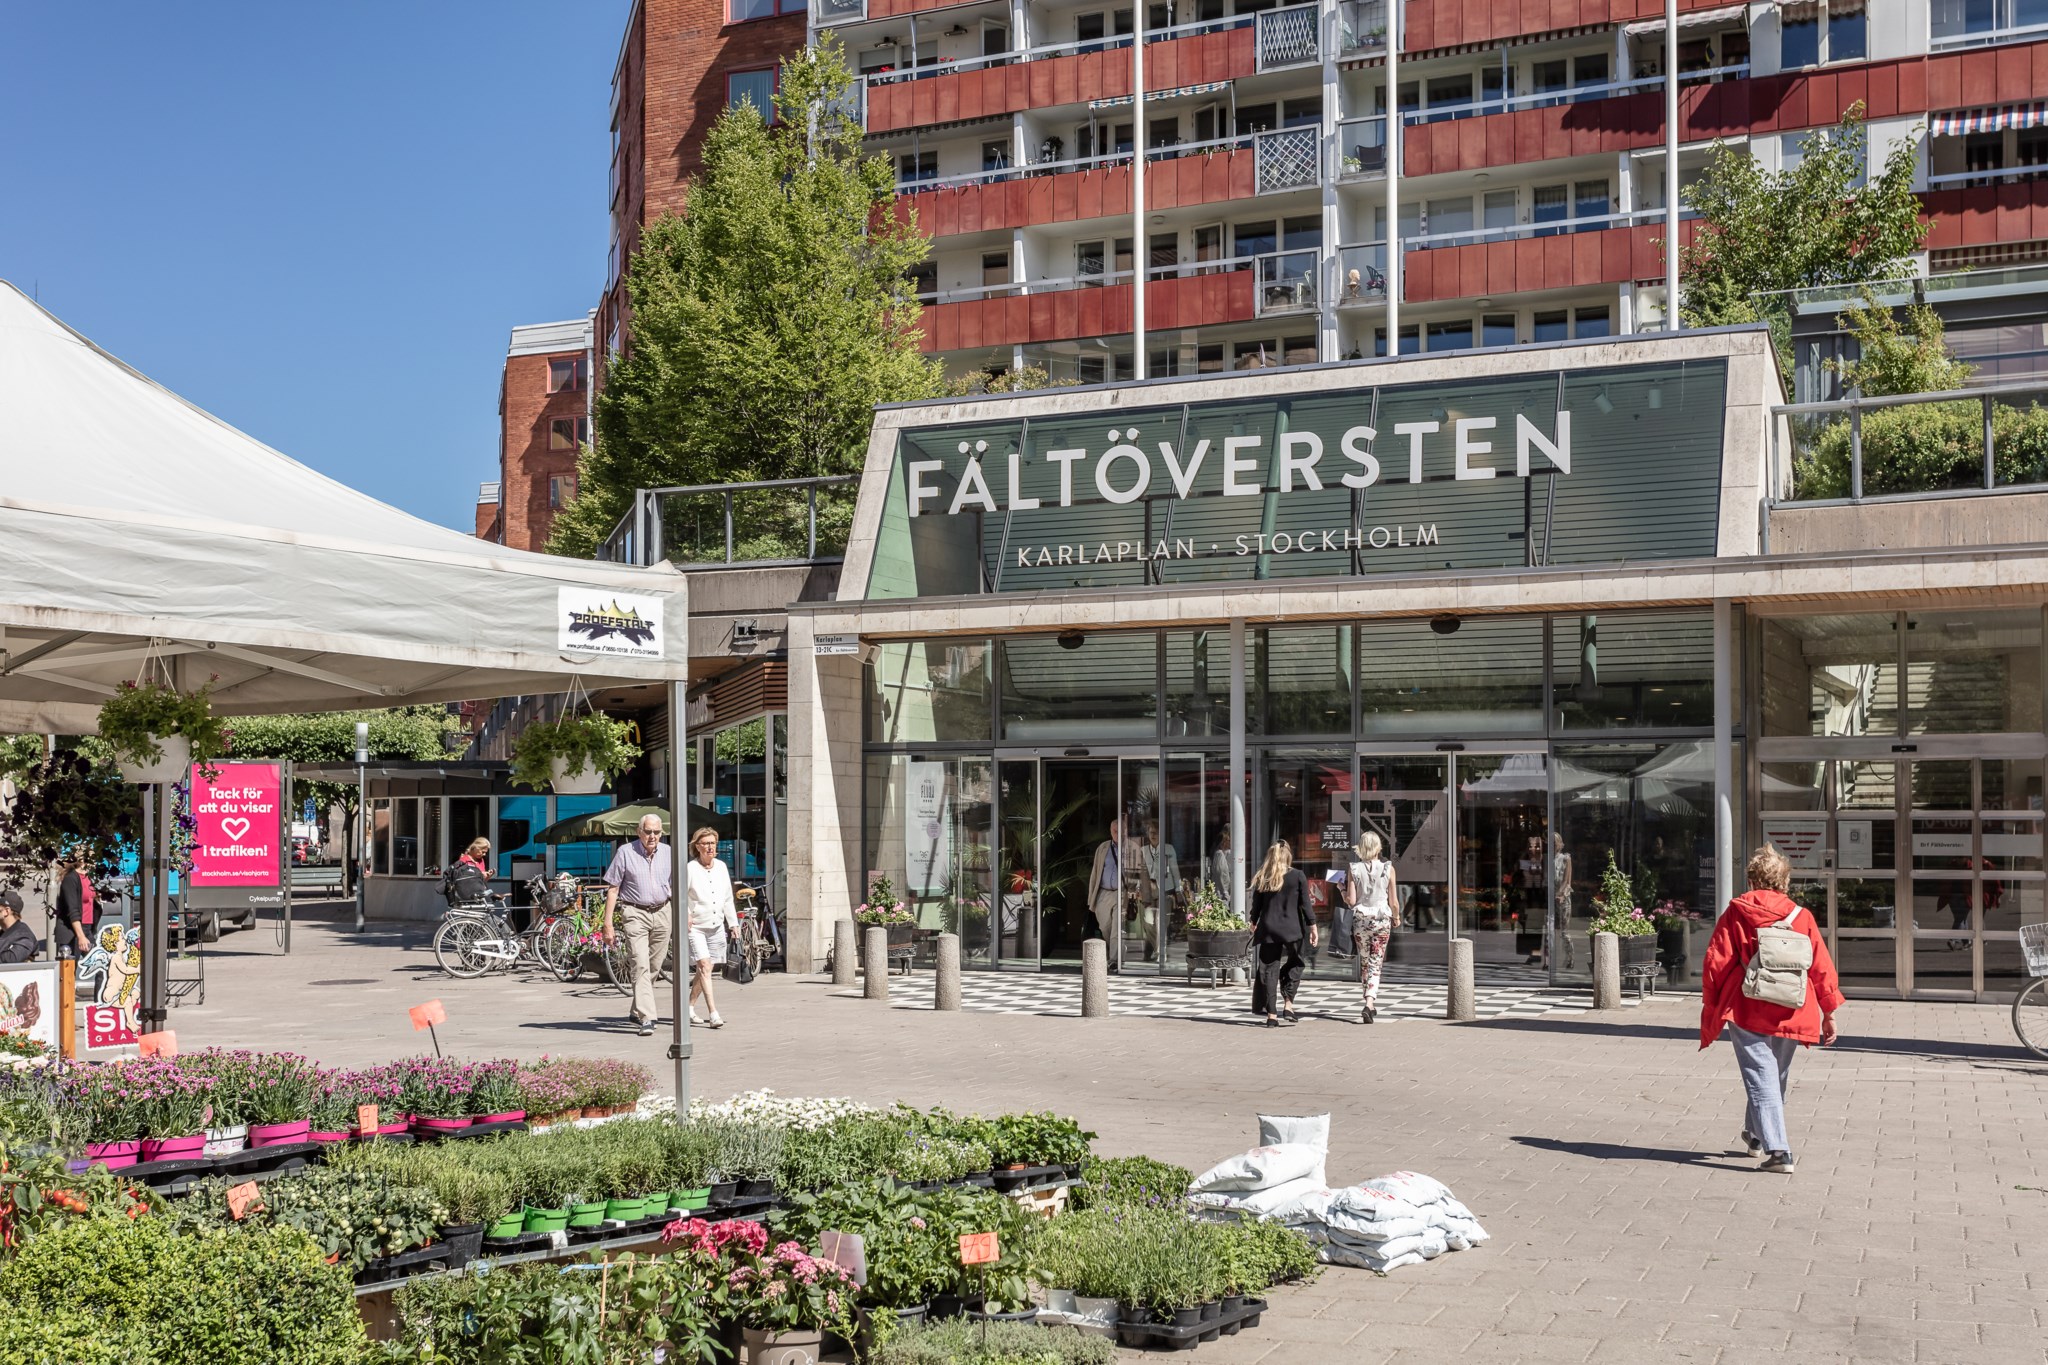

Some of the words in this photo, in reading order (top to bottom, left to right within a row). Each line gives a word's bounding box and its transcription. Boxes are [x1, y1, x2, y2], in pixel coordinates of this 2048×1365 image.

[908, 410, 1571, 518] FÄLTÖVERSTEN
[1018, 538, 1194, 567] KARLAPLAN
[1235, 523, 1440, 556] STOCKHOLM
[816, 636, 842, 644] Karlaplan
[209, 787, 240, 799] Tack
[243, 787, 263, 799] för
[198, 802, 218, 813] att
[220, 802, 238, 813] du
[240, 802, 273, 813] visar
[203, 845, 207, 857] i
[210, 845, 268, 857] trafiken!
[249, 895, 281, 903] Cykelpump
